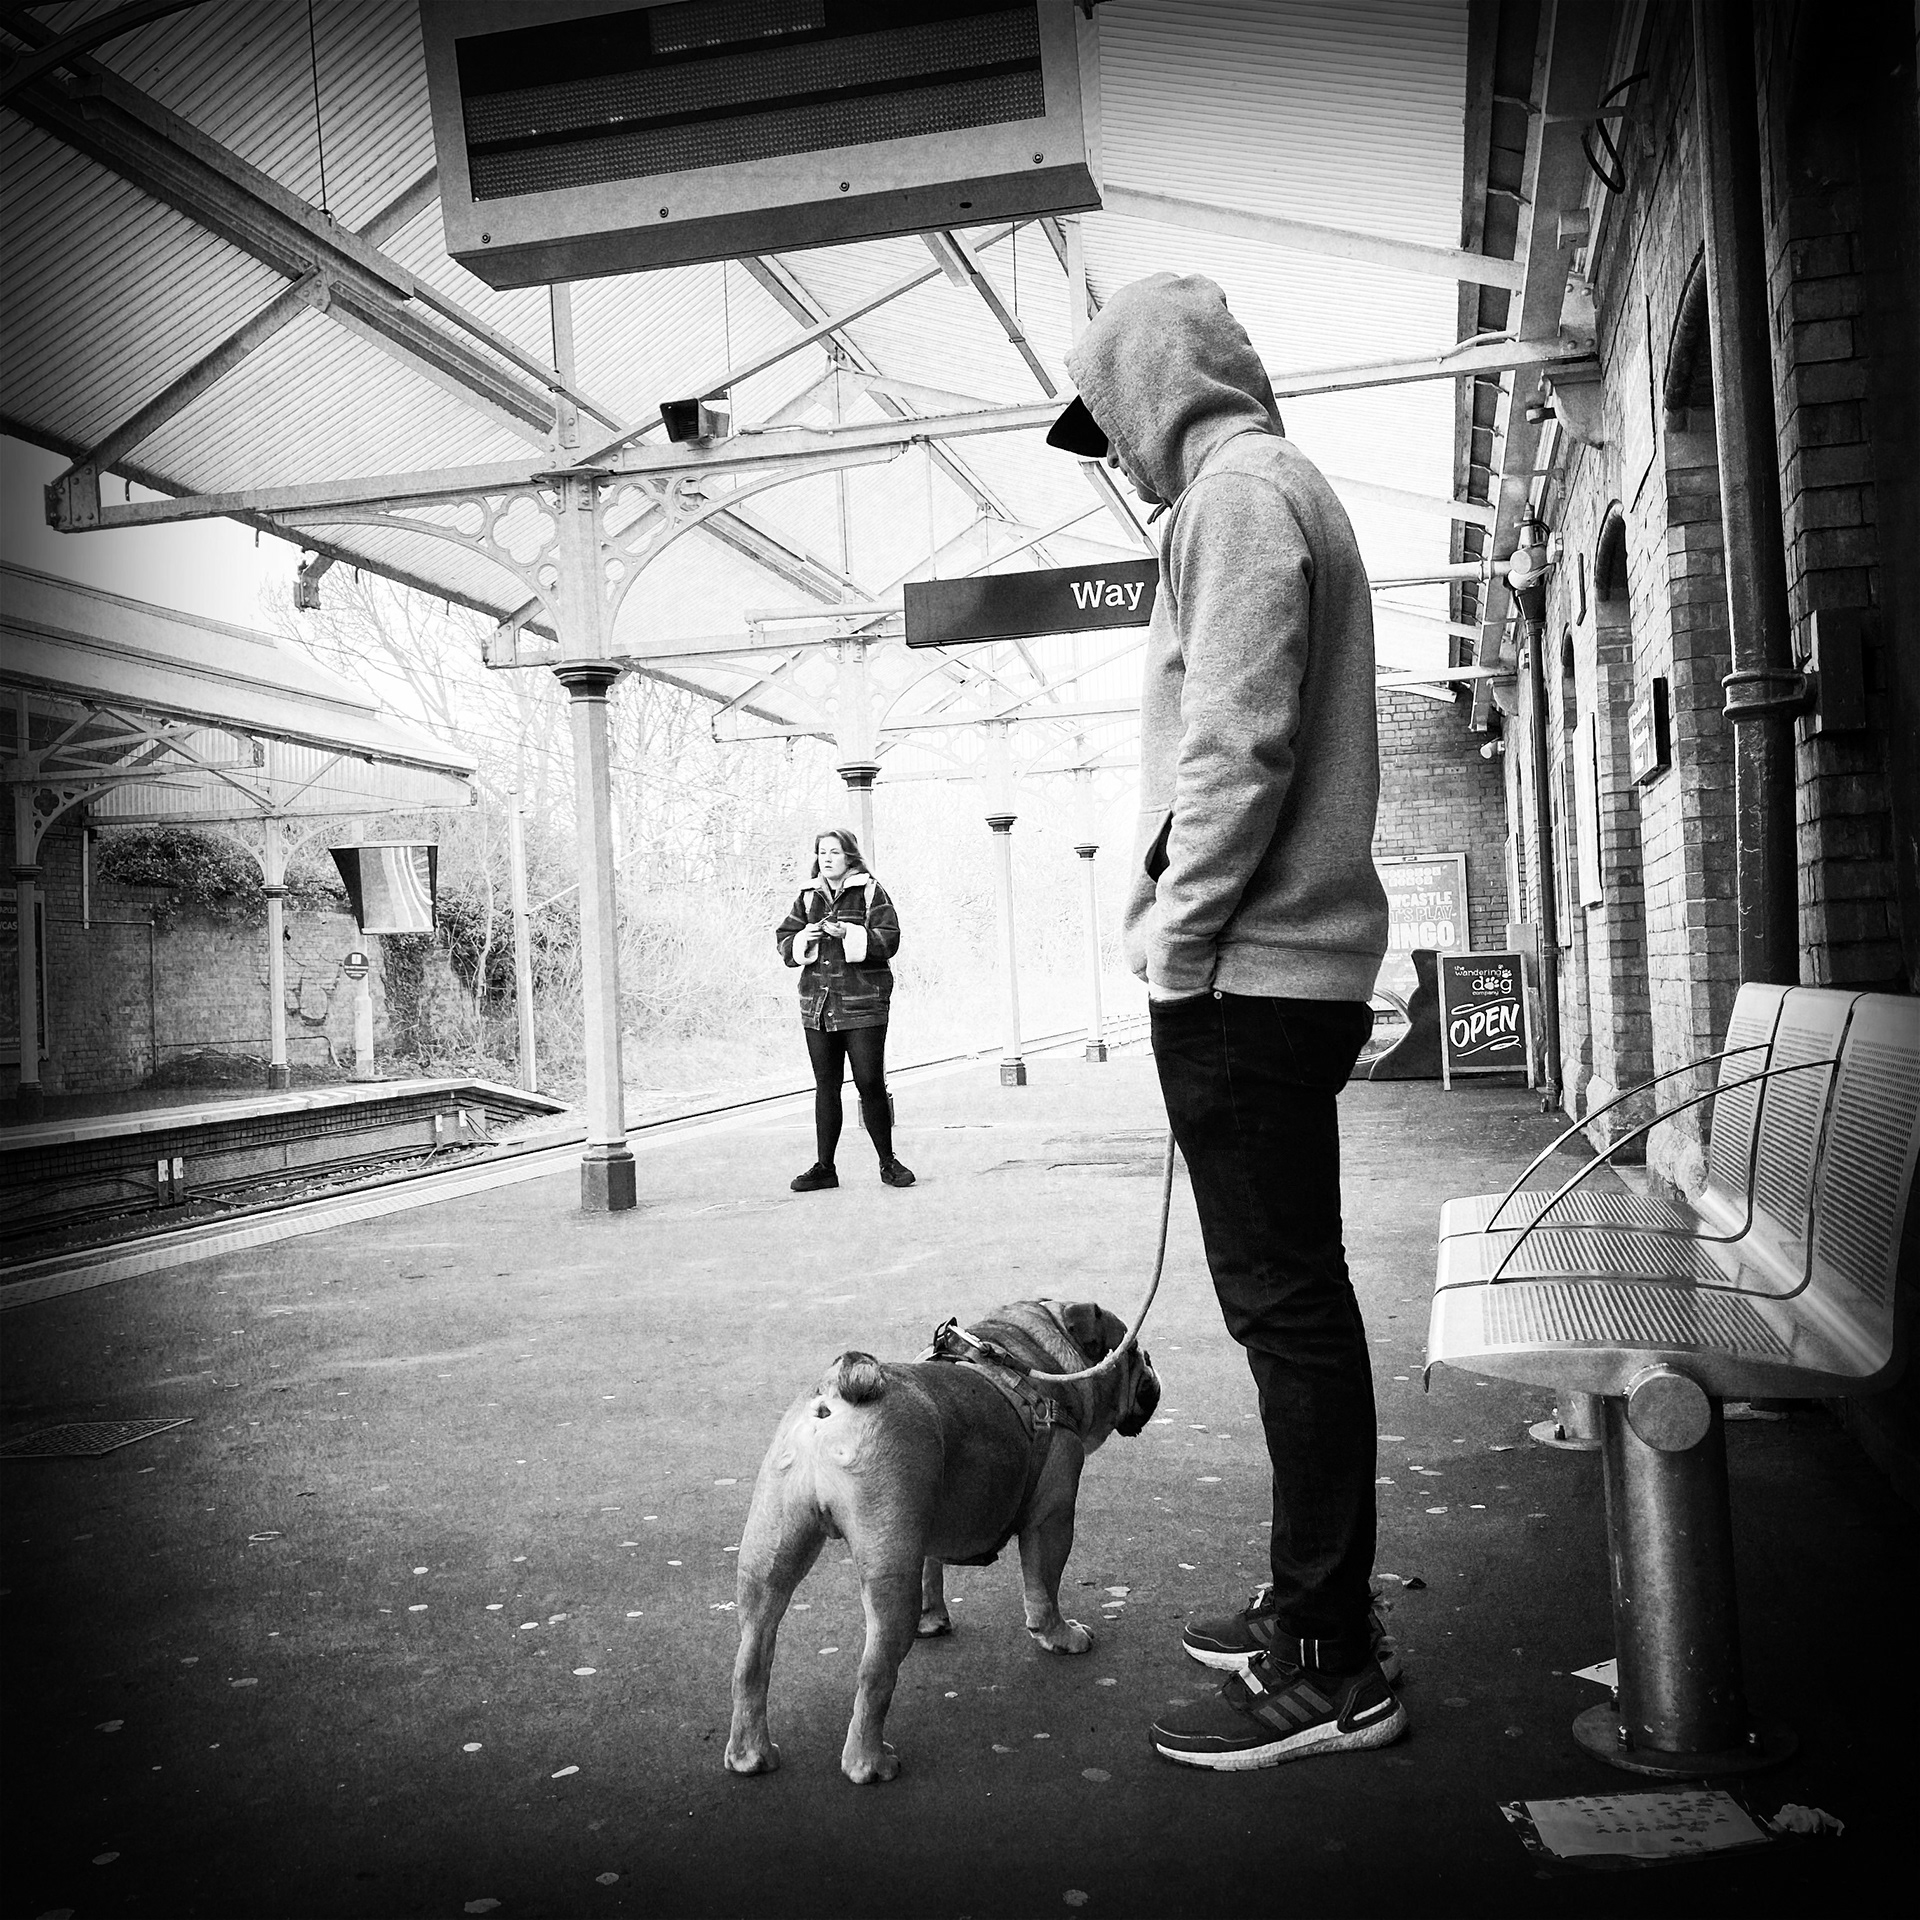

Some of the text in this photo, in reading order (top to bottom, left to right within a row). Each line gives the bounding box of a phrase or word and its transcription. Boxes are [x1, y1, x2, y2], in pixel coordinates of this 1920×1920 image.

[1069, 580, 1145, 611] Way
[1415, 905, 1452, 922] PLAY
[1455, 968, 1502, 977] wandering
[1450, 1003, 1520, 1048] OPEN
